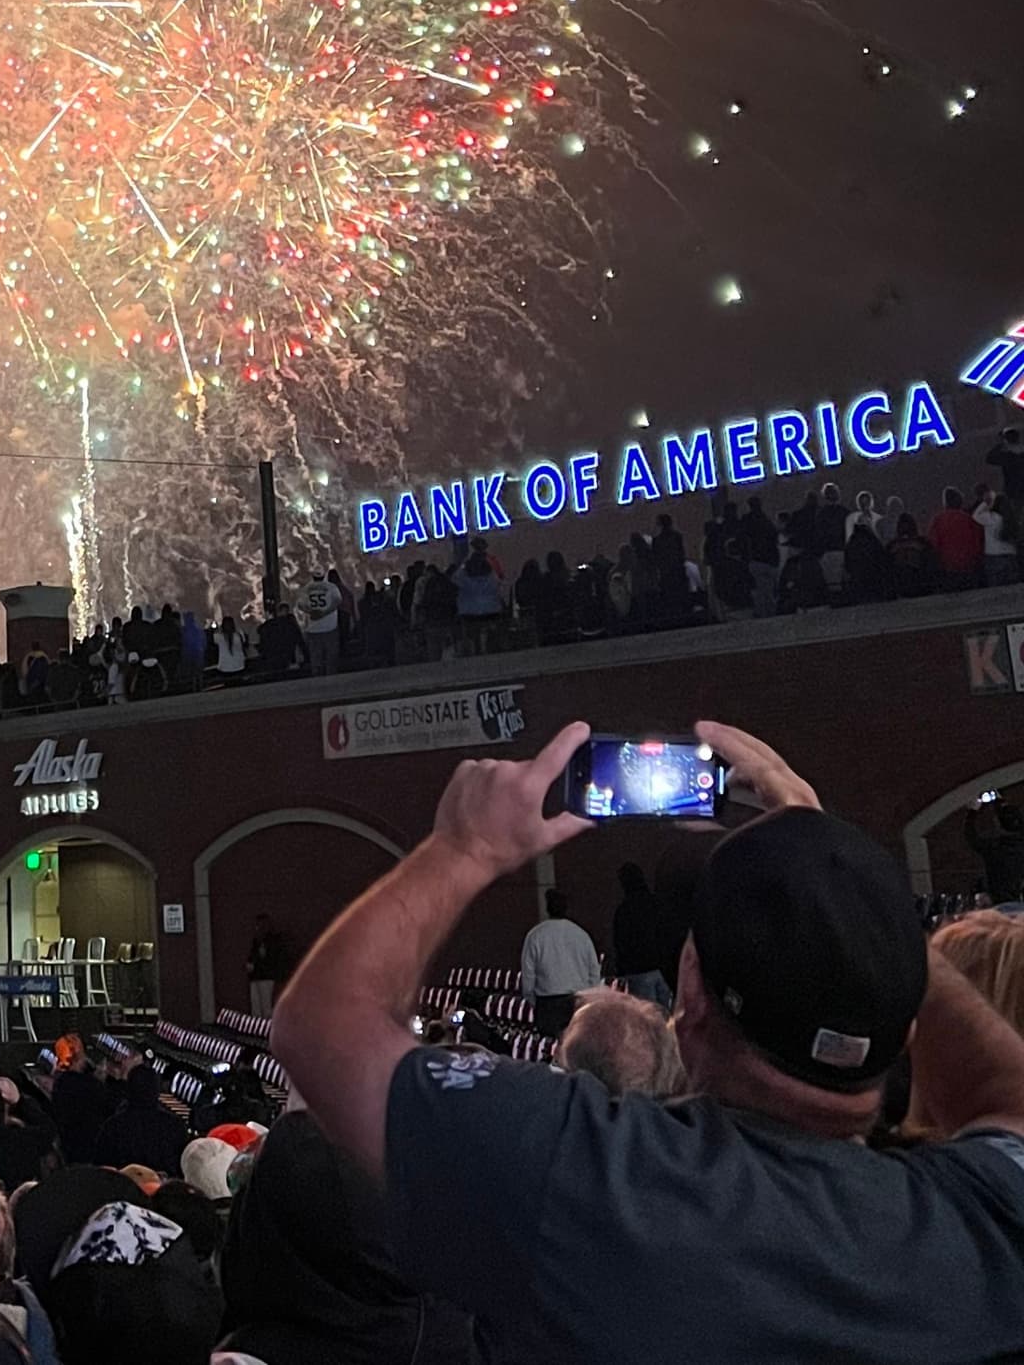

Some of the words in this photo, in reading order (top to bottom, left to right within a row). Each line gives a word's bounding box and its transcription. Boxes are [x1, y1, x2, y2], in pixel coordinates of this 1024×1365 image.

[359, 472, 511, 553] BANK
[525, 452, 599, 520] OF
[618, 380, 955, 505] AMERICA
[309, 594, 326, 608] 55
[496, 708, 525, 739] KIDS
[13, 738, 103, 786] Alaska
